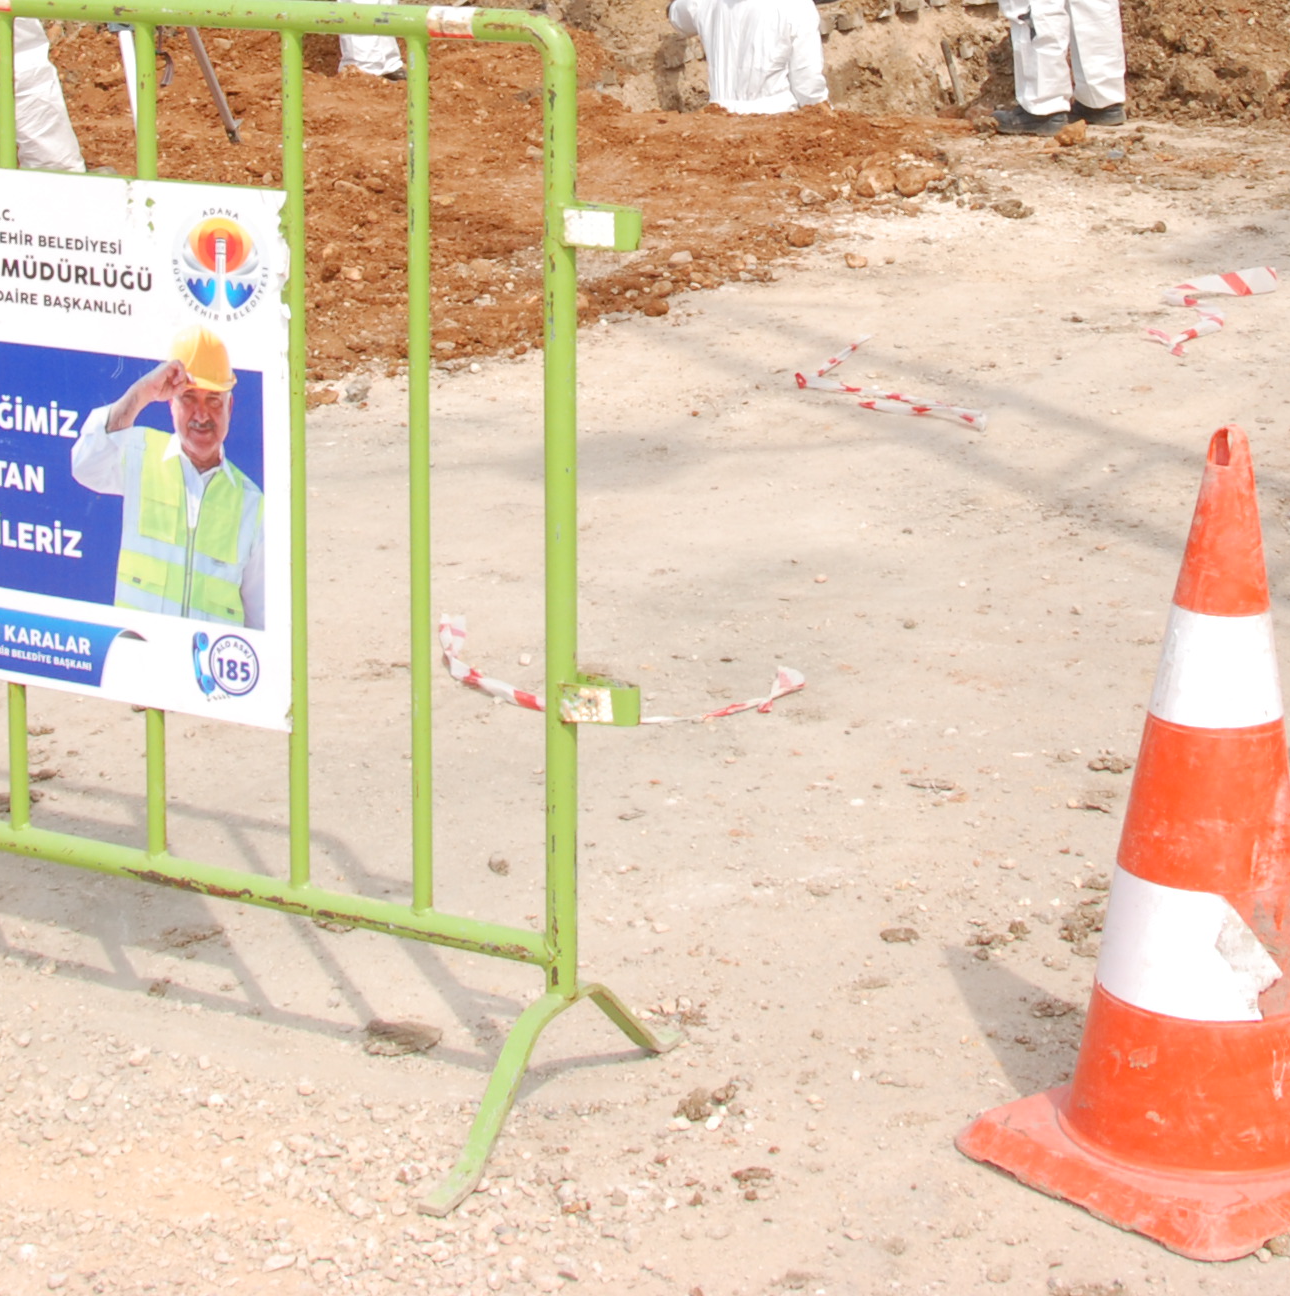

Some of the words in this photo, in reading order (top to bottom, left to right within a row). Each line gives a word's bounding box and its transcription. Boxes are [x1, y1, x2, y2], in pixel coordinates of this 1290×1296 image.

[202, 207, 239, 220] ADANA
[38, 235, 122, 255] BELEDİYESİ
[1, 255, 153, 292] MÜDÜRLÜĞÜ
[44, 295, 133, 316] BAŞKANLIĞI
[4, 624, 92, 655] KARALAR
[216, 640, 231, 654] ALO
[11, 647, 52, 665] BELEDİYE
[53, 655, 93, 672] BAŞKANI
[217, 657, 251, 682] 185
